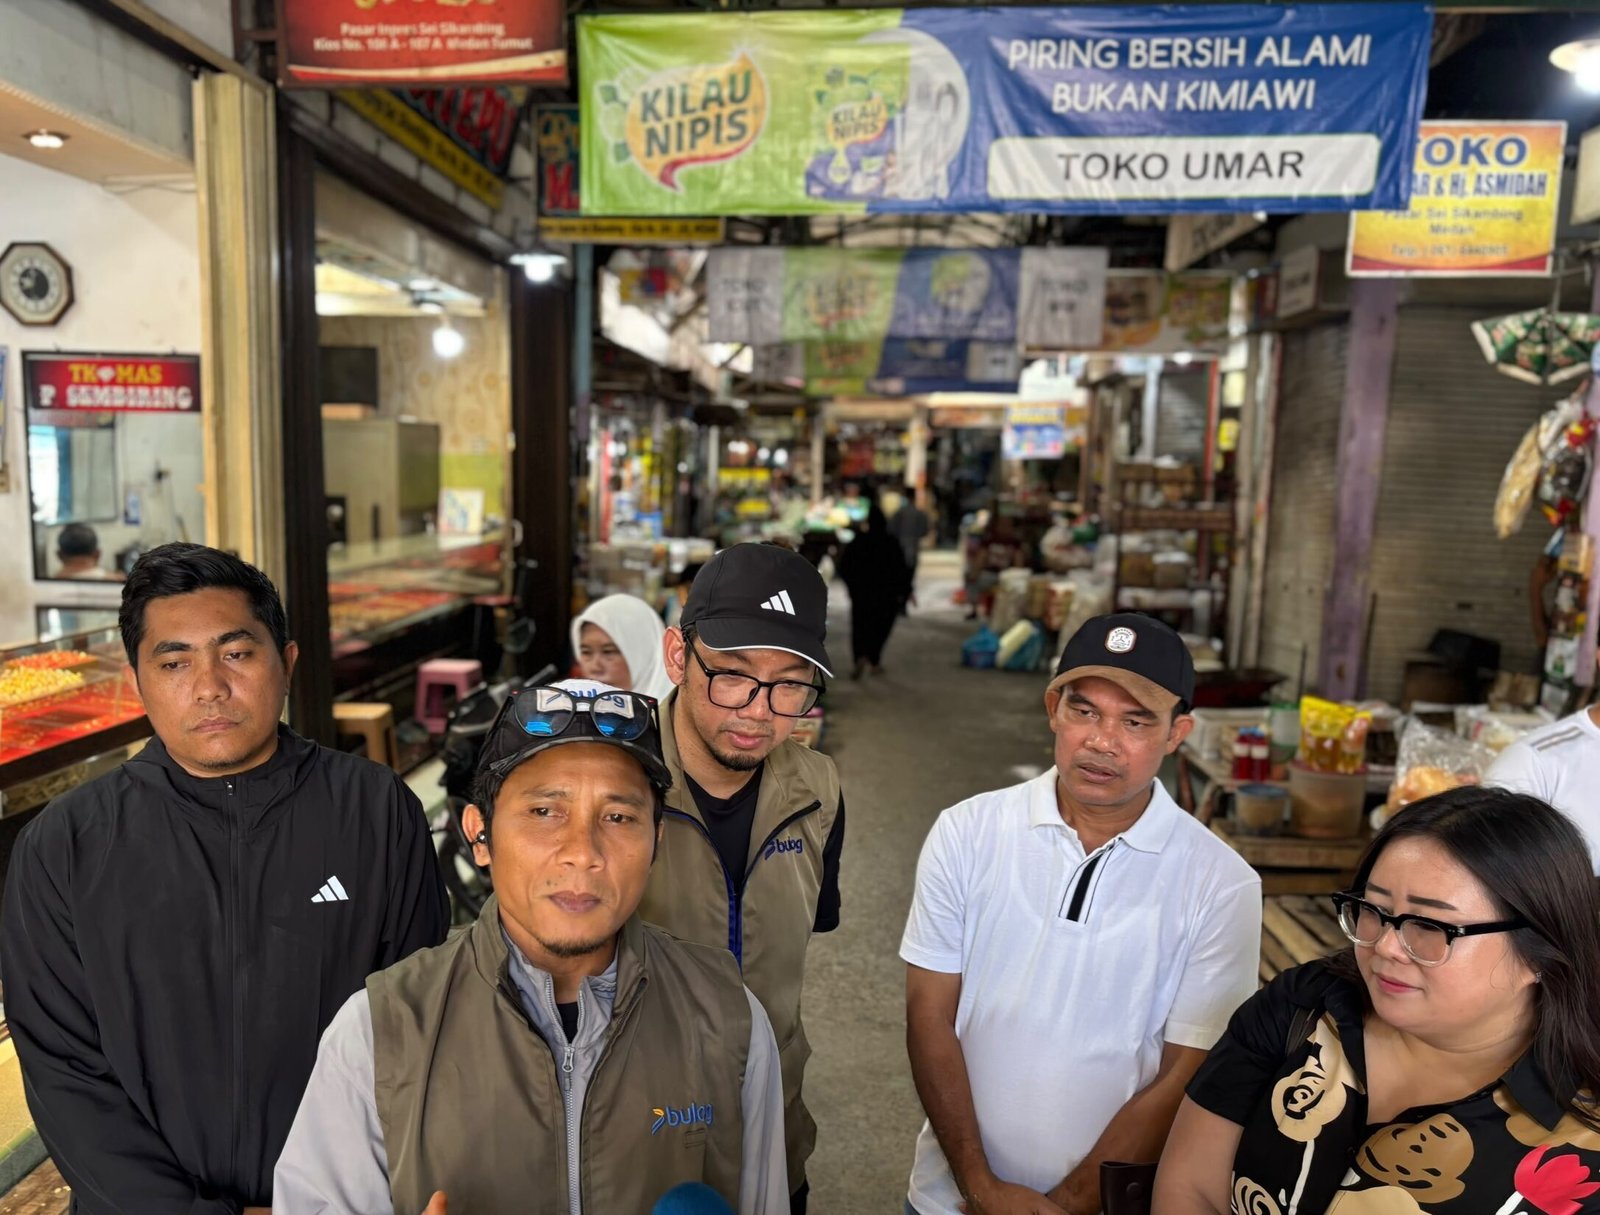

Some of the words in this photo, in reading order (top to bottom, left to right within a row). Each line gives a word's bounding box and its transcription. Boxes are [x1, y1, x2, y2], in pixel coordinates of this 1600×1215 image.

[1008, 38, 1119, 70] PIRING
[1128, 36, 1246, 69] BERSIH
[1255, 34, 1372, 67] ALAMI
[641, 69, 753, 124] KILAU
[1051, 80, 1167, 113] BUKAN
[1176, 78, 1316, 111] KIMIAWI
[832, 103, 881, 126] KILAU
[644, 108, 749, 159] NIPIS
[833, 121, 880, 142] NIPIS
[1057, 152, 1169, 182] TOKO
[1183, 149, 1305, 180] UMAR
[1418, 136, 1528, 167] OKO
[1435, 175, 1445, 196] &
[1473, 172, 1548, 197] ASMIDAH
[115, 363, 164, 385] MAS
[66, 383, 194, 410] SEMBIRING
